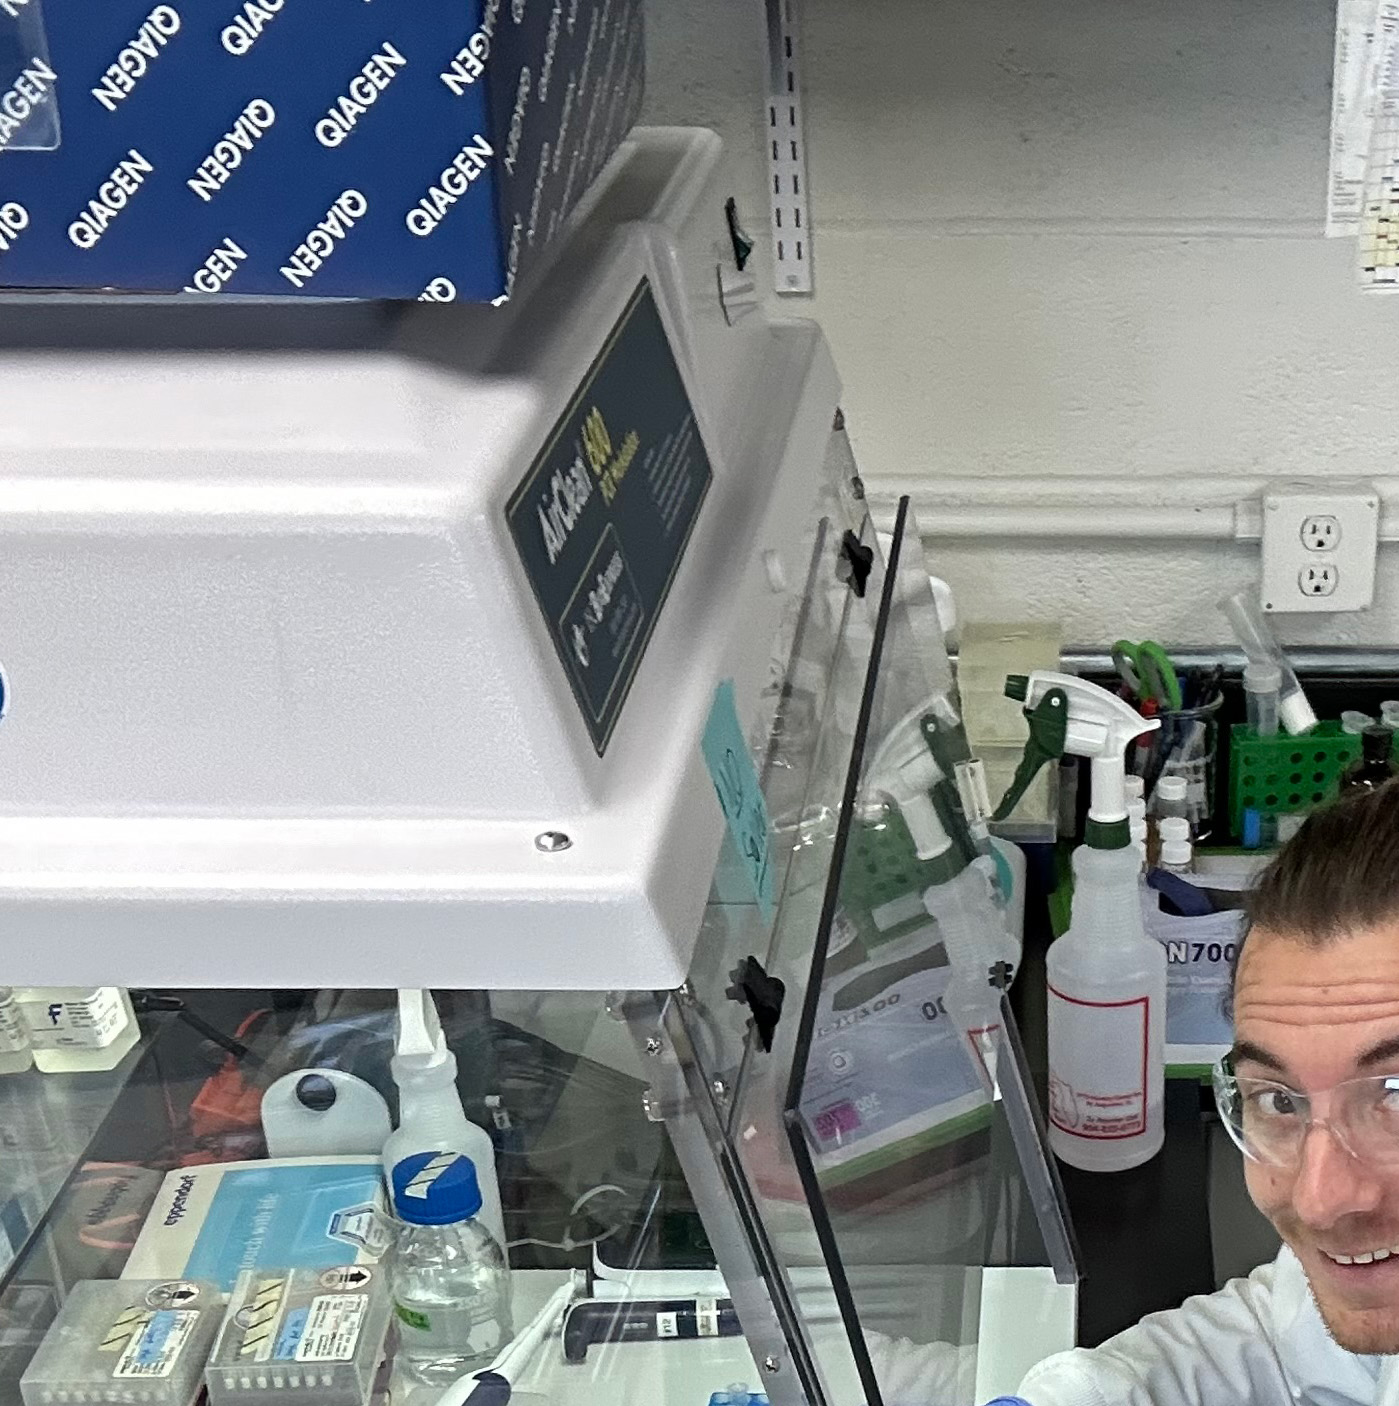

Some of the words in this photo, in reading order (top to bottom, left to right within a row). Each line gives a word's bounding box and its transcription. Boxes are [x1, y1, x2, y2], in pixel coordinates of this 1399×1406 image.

[92, 5, 180, 111] QIAGEN
[314, 42, 407, 148] QIAGEN
[68, 149, 154, 250] QIAGEN
[187, 98, 276, 202] QIAGEN
[406, 134, 495, 238] QIAGEN
[184, 237, 249, 295] GEN
[279, 188, 368, 288] QIAGEN
[163, 1174, 199, 1227] eppendorf
